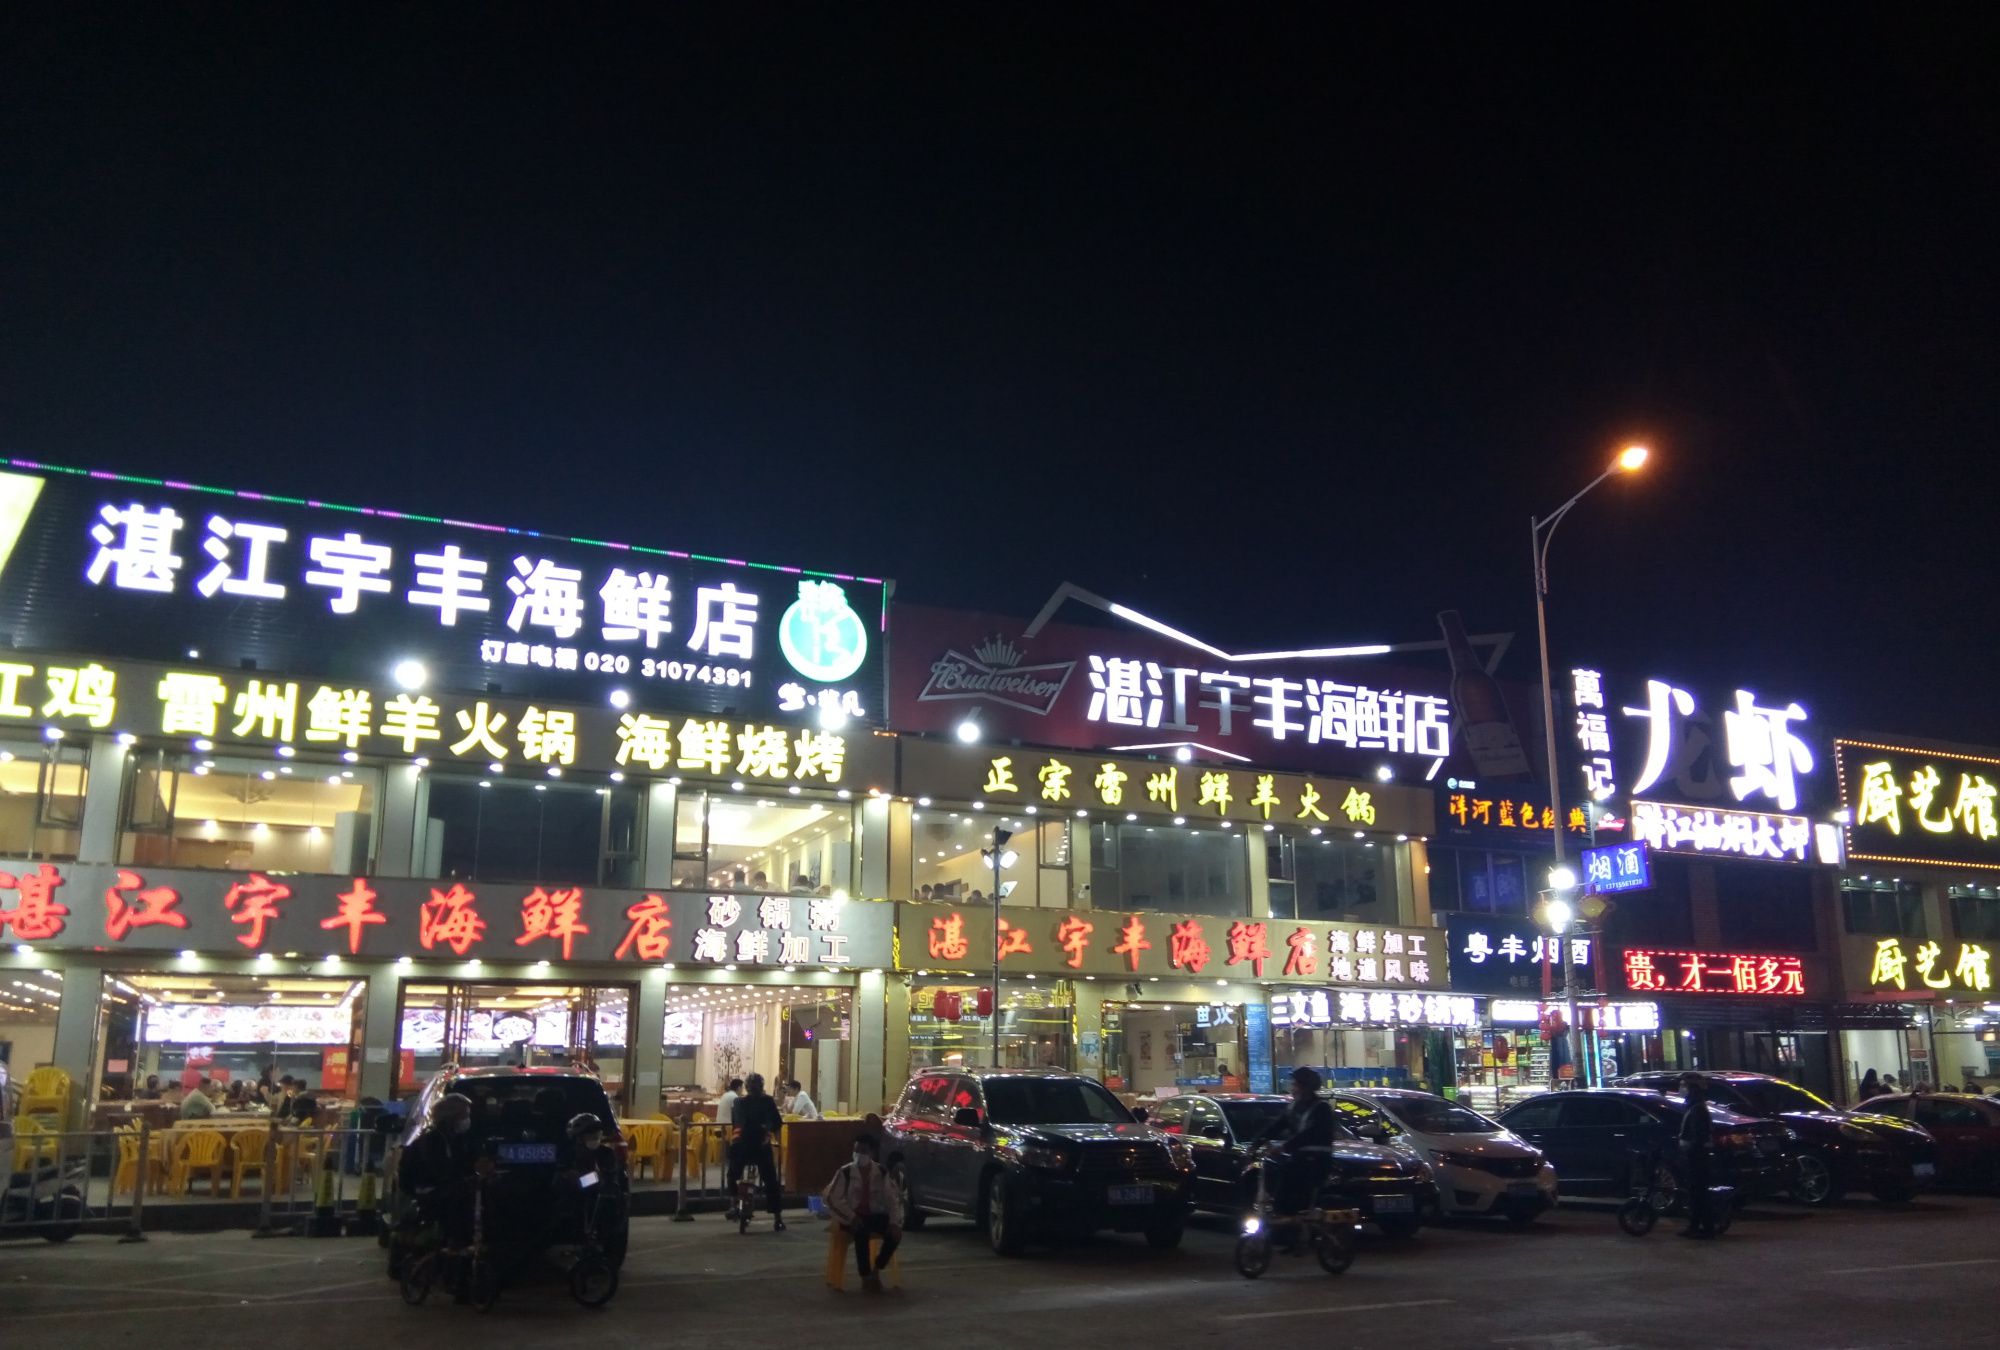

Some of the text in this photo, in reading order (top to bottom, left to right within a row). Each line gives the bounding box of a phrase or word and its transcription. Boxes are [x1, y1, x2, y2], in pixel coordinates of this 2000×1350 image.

[88, 505, 758, 659] 湛江宇丰海鲜店
[585, 653, 630, 674] 020
[641, 658, 751, 688] 31074391
[931, 662, 1060, 697] Budweiser
[158, 672, 576, 765] 雷州鲜羊火锅
[615, 711, 847, 782] 海鲜烧烤
[1087, 655, 1450, 758] 湛江宇丰海鲜店
[983, 757, 1376, 826] 正宗雷州鲜羊火锅
[1858, 762, 1999, 840] 厨艺馆
[1588, 847, 1640, 882] 烟酒
[0, 864, 672, 960] 湛江宇丰海鲜店
[708, 894, 841, 931] 砂锅粥
[694, 927, 851, 964] 海鲜加工
[929, 912, 1318, 976] 湛江宇丰海鲜店
[1330, 929, 1428, 956] 海鲜加工
[1871, 938, 1991, 992] 厨艺馆
[1330, 957, 1430, 983] 地道风味
[1270, 990, 1332, 1025] 三文鱼
